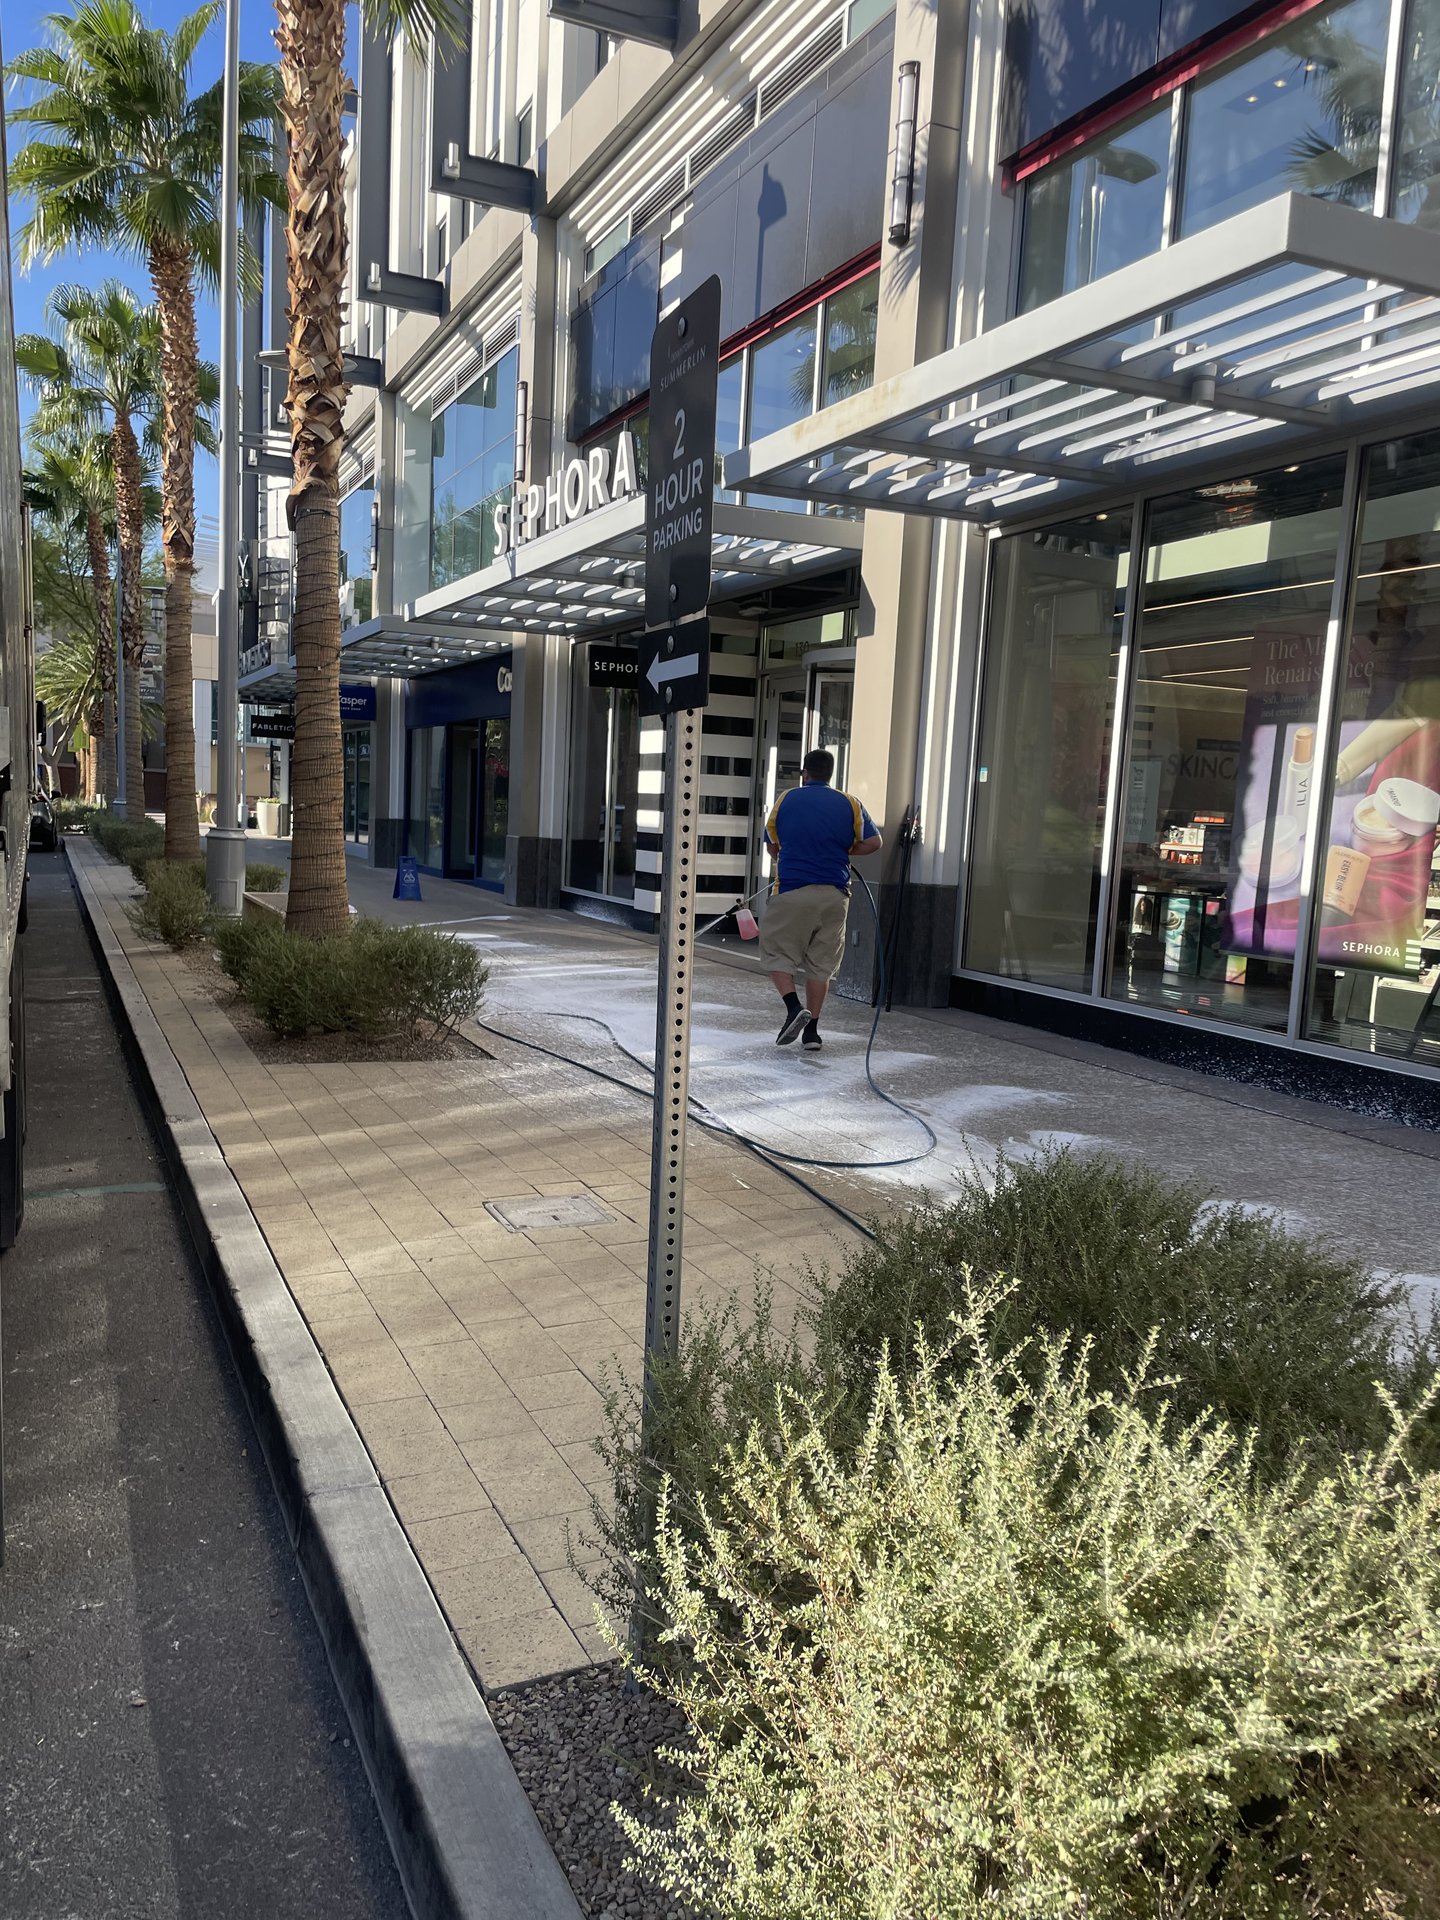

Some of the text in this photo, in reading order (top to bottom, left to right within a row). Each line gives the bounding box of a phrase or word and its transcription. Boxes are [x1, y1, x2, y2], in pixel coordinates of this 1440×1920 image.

[660, 344, 707, 392] SUMMERLIN
[673, 408, 686, 460] 2
[494, 431, 638, 556] SEPHORA
[655, 457, 703, 519] HOUR
[653, 507, 703, 554] PARKING
[1266, 639, 1299, 660] The
[340, 697, 368, 707] asper
[1165, 753, 1239, 780] SKINC
[1296, 777, 1308, 806] ILIA
[1342, 941, 1400, 957] SEPHORA
